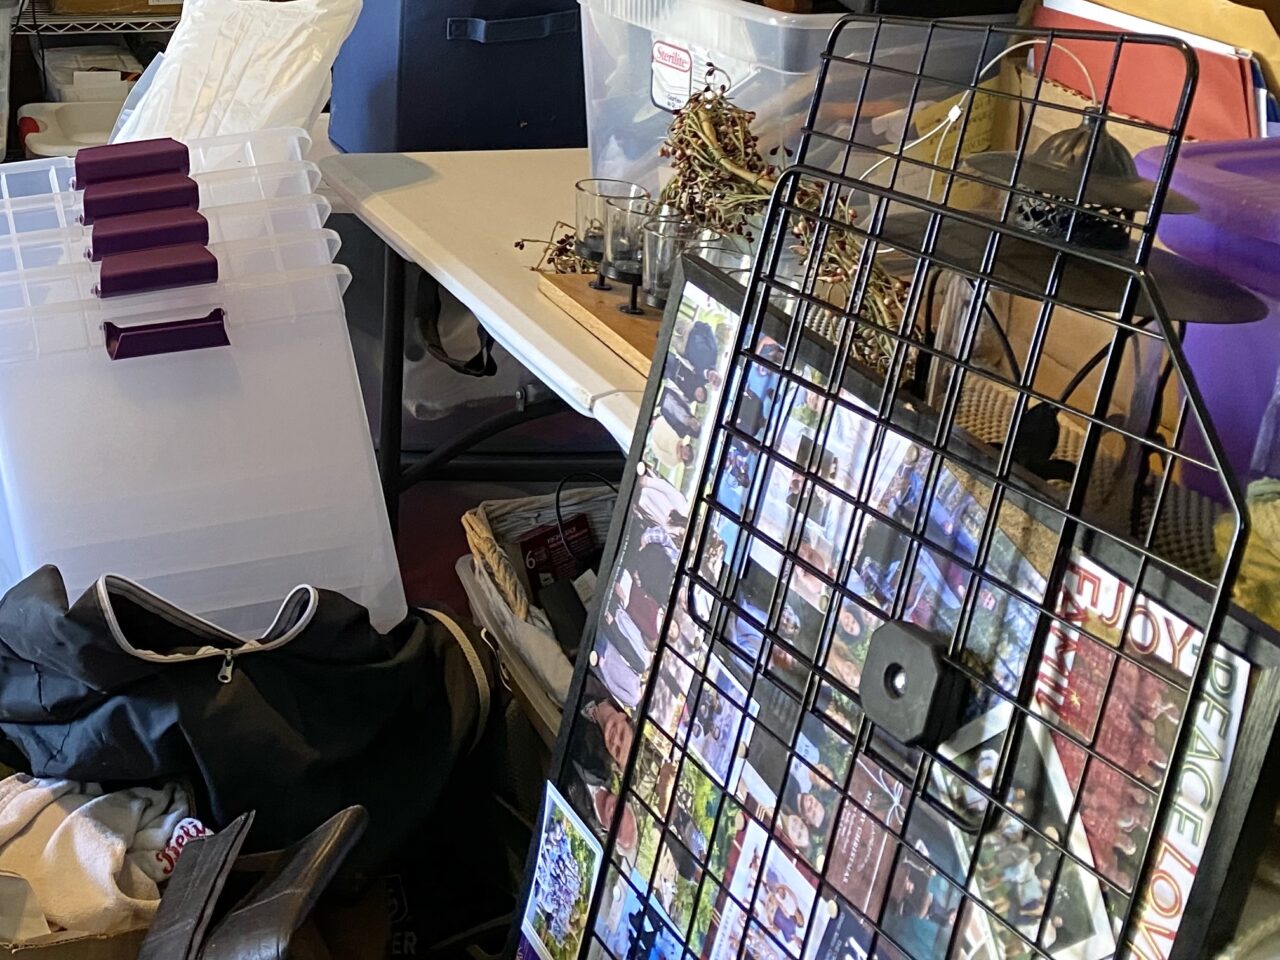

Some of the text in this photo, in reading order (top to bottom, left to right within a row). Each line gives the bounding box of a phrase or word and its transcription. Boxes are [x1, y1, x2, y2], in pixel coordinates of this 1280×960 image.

[656, 45, 689, 68] Sterilite
[525, 550, 536, 569] 6
[1034, 562, 1102, 720] FAMIL
[1099, 580, 1196, 671] JOY
